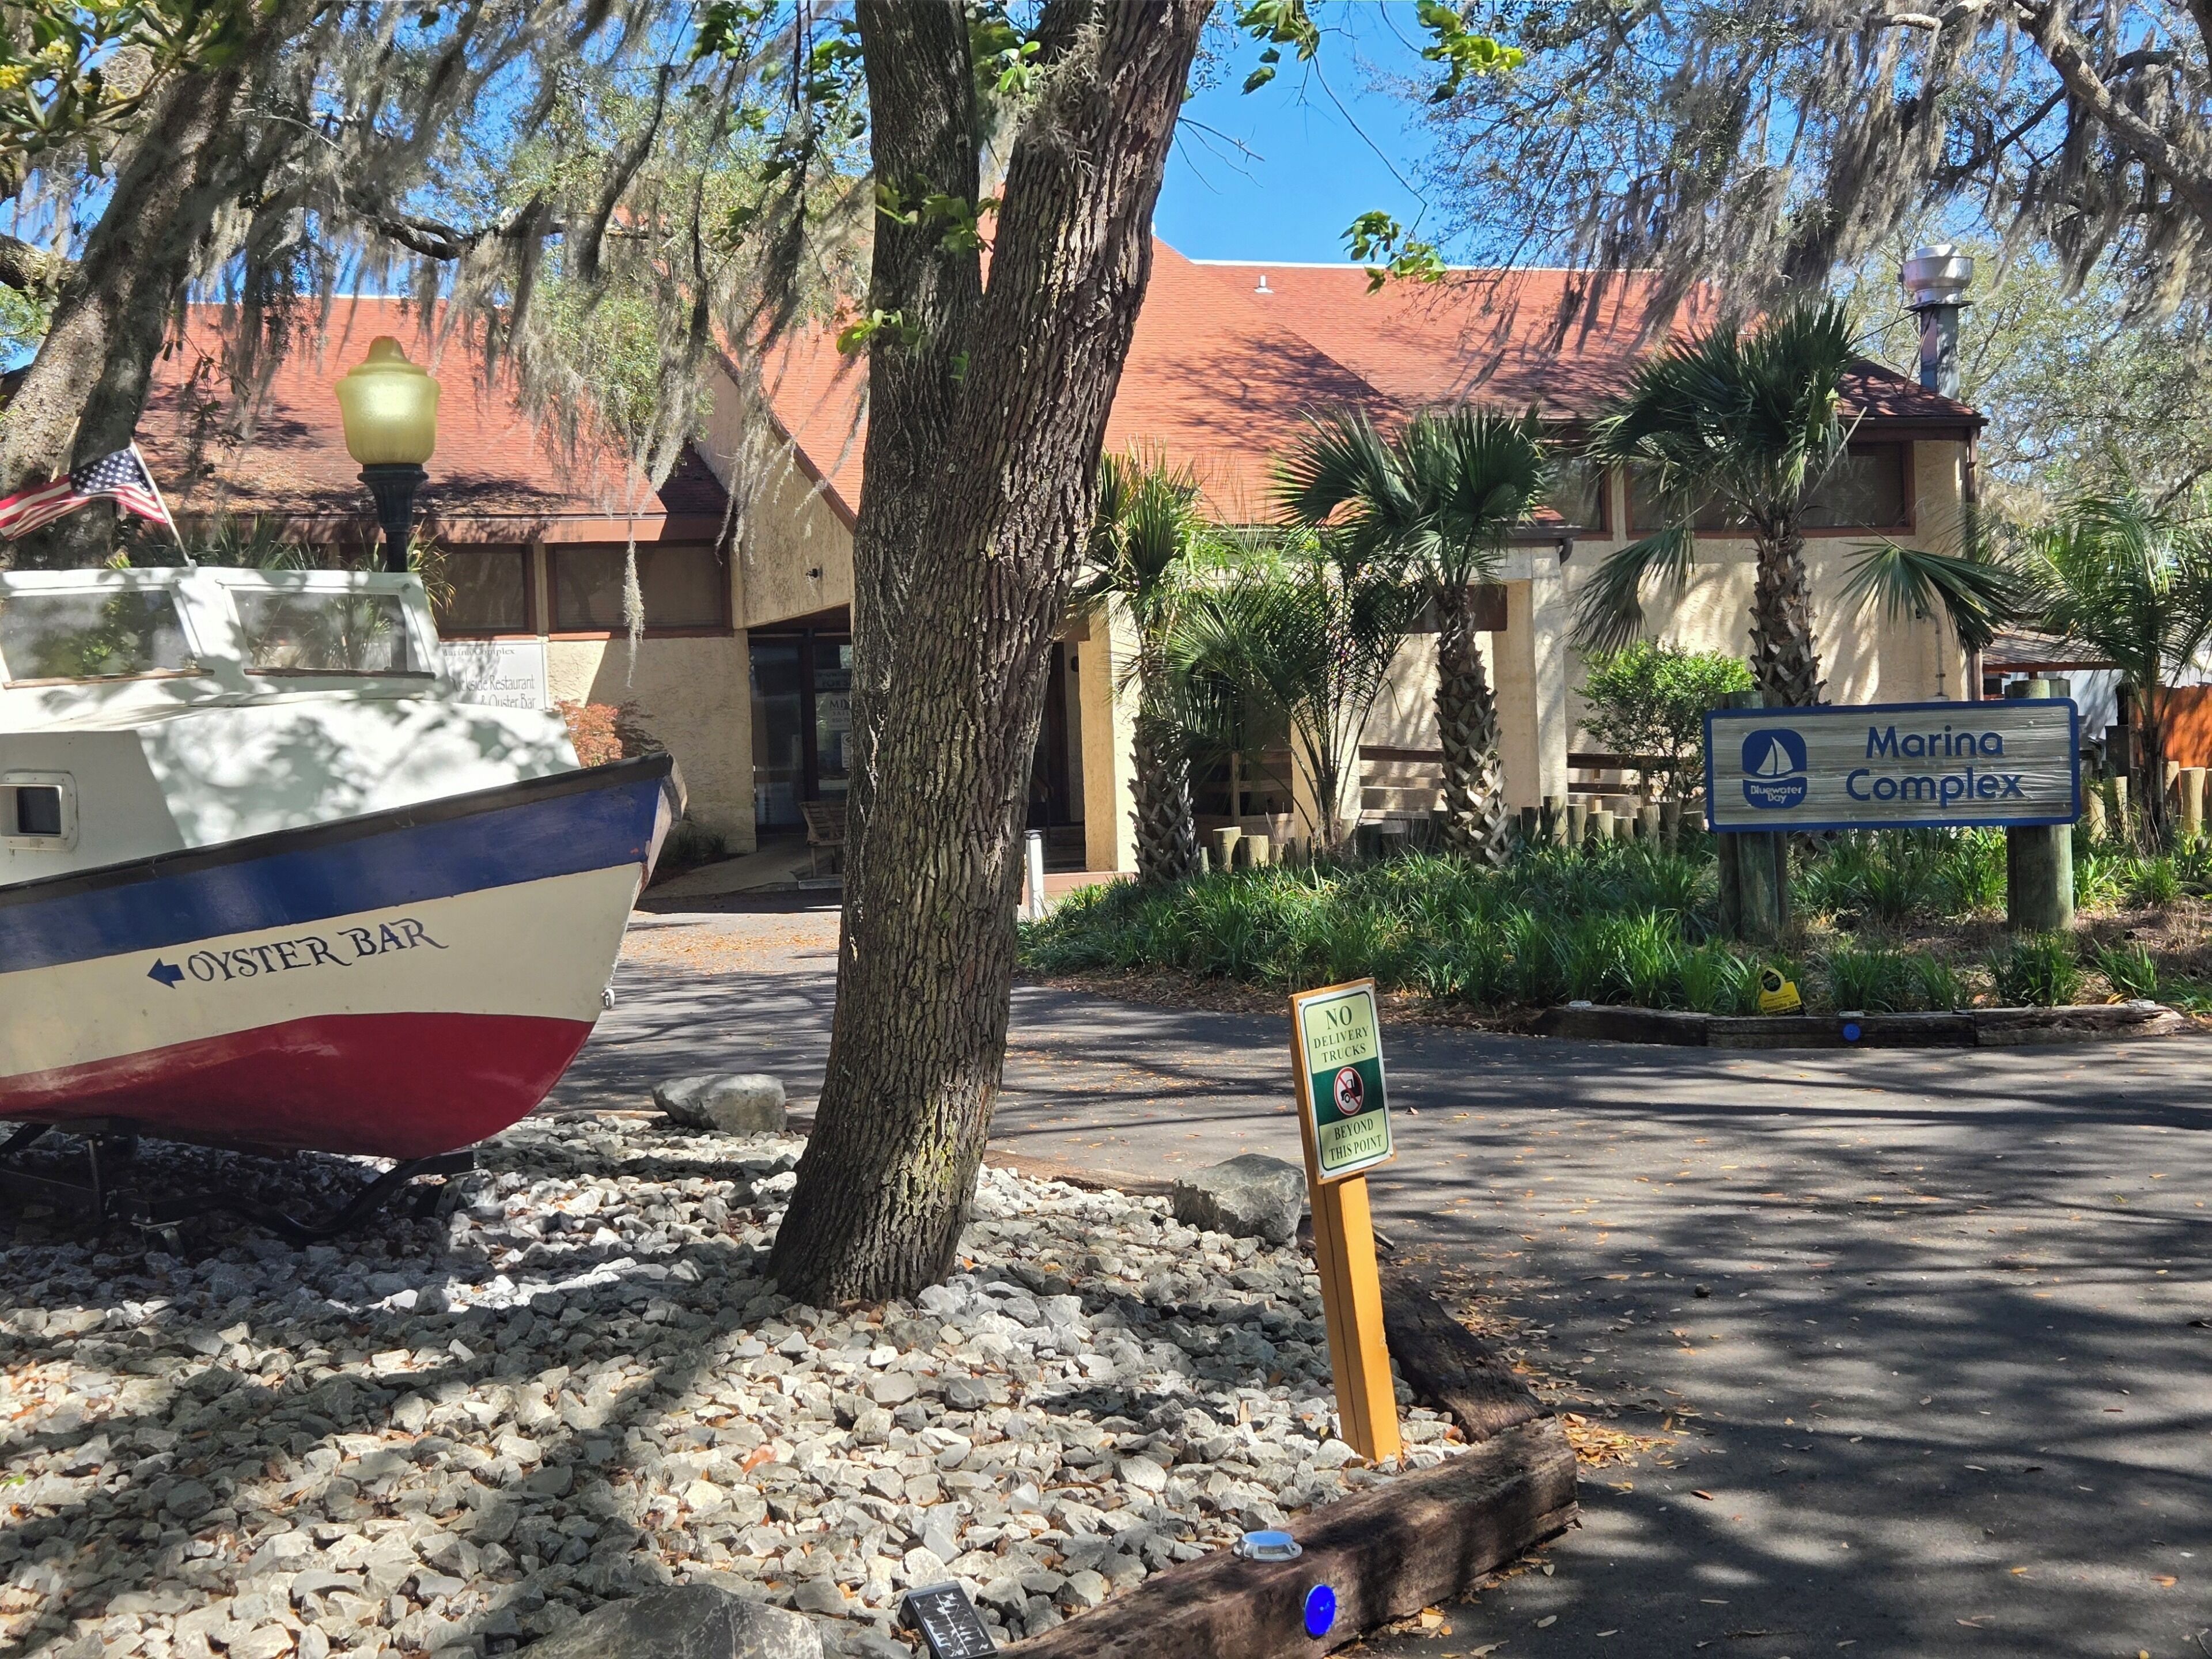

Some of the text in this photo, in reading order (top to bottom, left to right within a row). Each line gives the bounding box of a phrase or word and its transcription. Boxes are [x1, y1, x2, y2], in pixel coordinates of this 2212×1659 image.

[474, 647, 515, 657] Complex
[490, 674, 535, 691] Restaurant
[520, 694, 536, 709] Bar
[1866, 725, 2004, 759] Marina
[1751, 785, 1802, 794] Bluewater
[1846, 767, 2026, 809] Complex
[188, 918, 449, 982] OYSTER BAR
[1325, 1005, 1352, 1030] NO
[1313, 1025, 1369, 1049] DELIVERY
[1321, 1043, 1366, 1063] TRUCKS
[1334, 1118, 1373, 1141] BEYOND
[1329, 1134, 1382, 1161] THIS POINT
